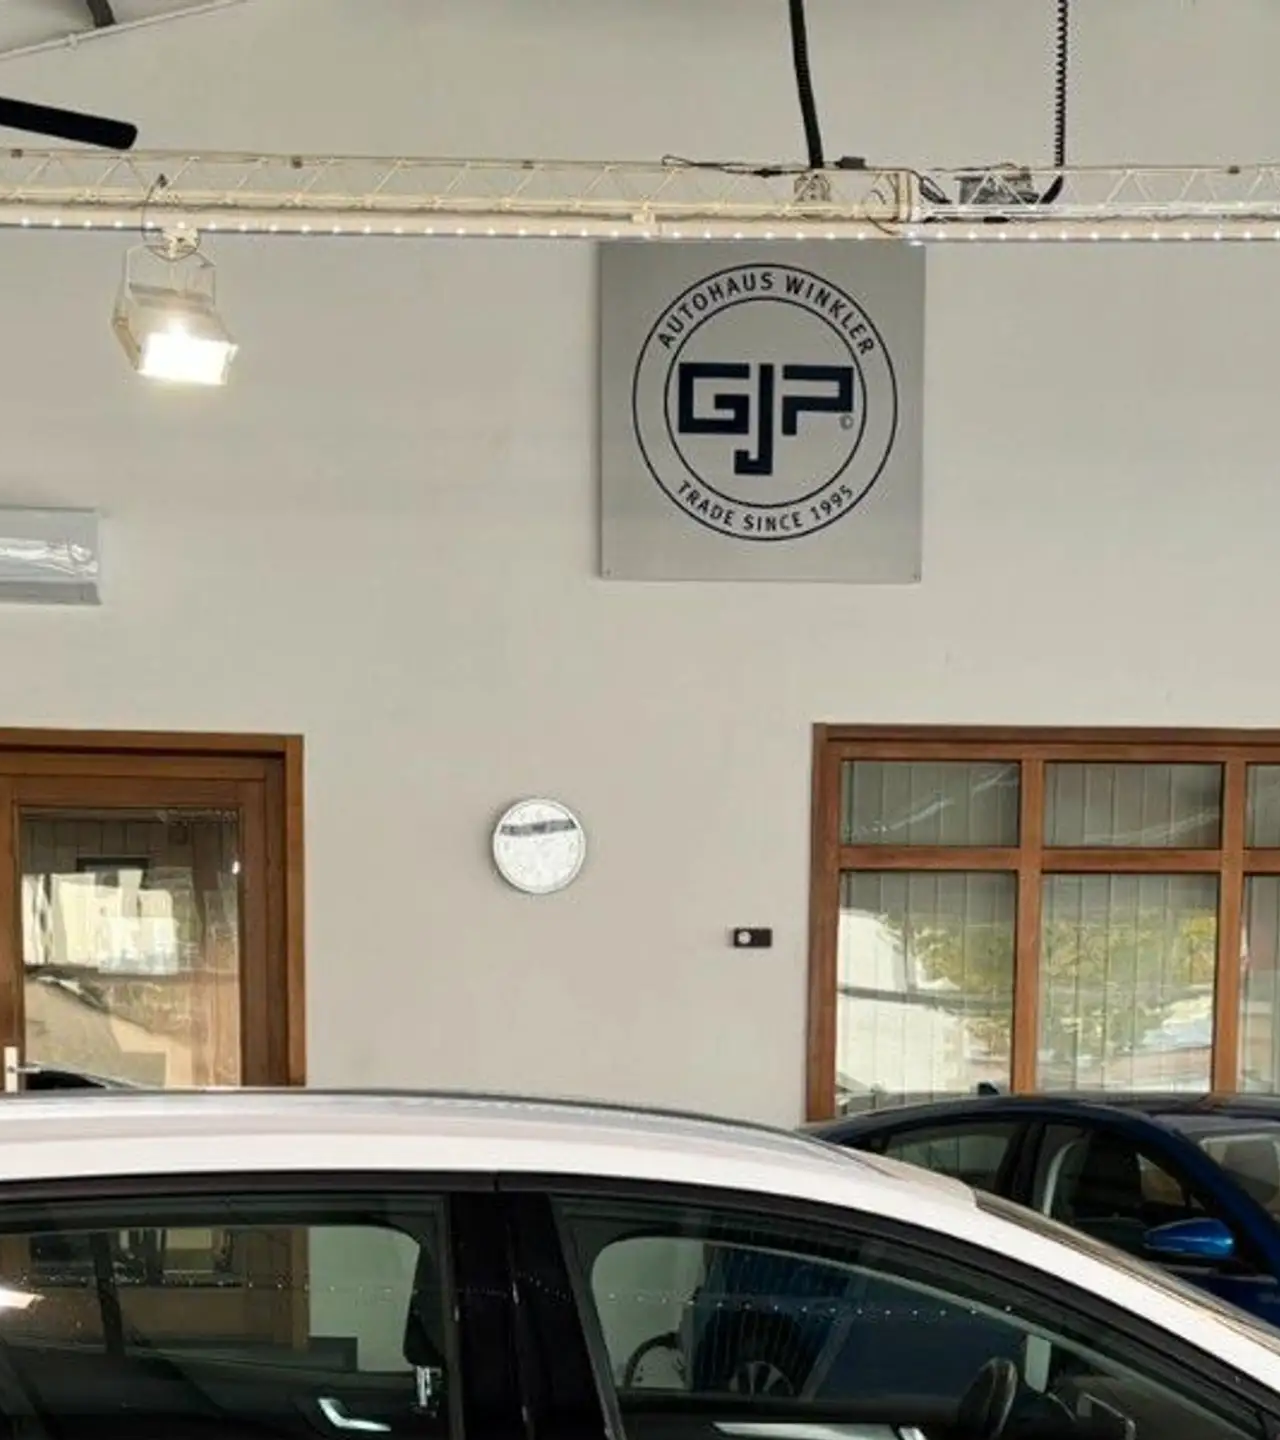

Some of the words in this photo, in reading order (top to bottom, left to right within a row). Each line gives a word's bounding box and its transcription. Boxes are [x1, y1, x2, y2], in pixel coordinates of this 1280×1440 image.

[658, 272, 773, 349] AUTOHAUS
[786, 275, 874, 355] WINKLER
[679, 363, 854, 476] GJP
[677, 480, 735, 526] TRADE
[743, 511, 804, 533] SINCE
[810, 485, 853, 521] 1995
